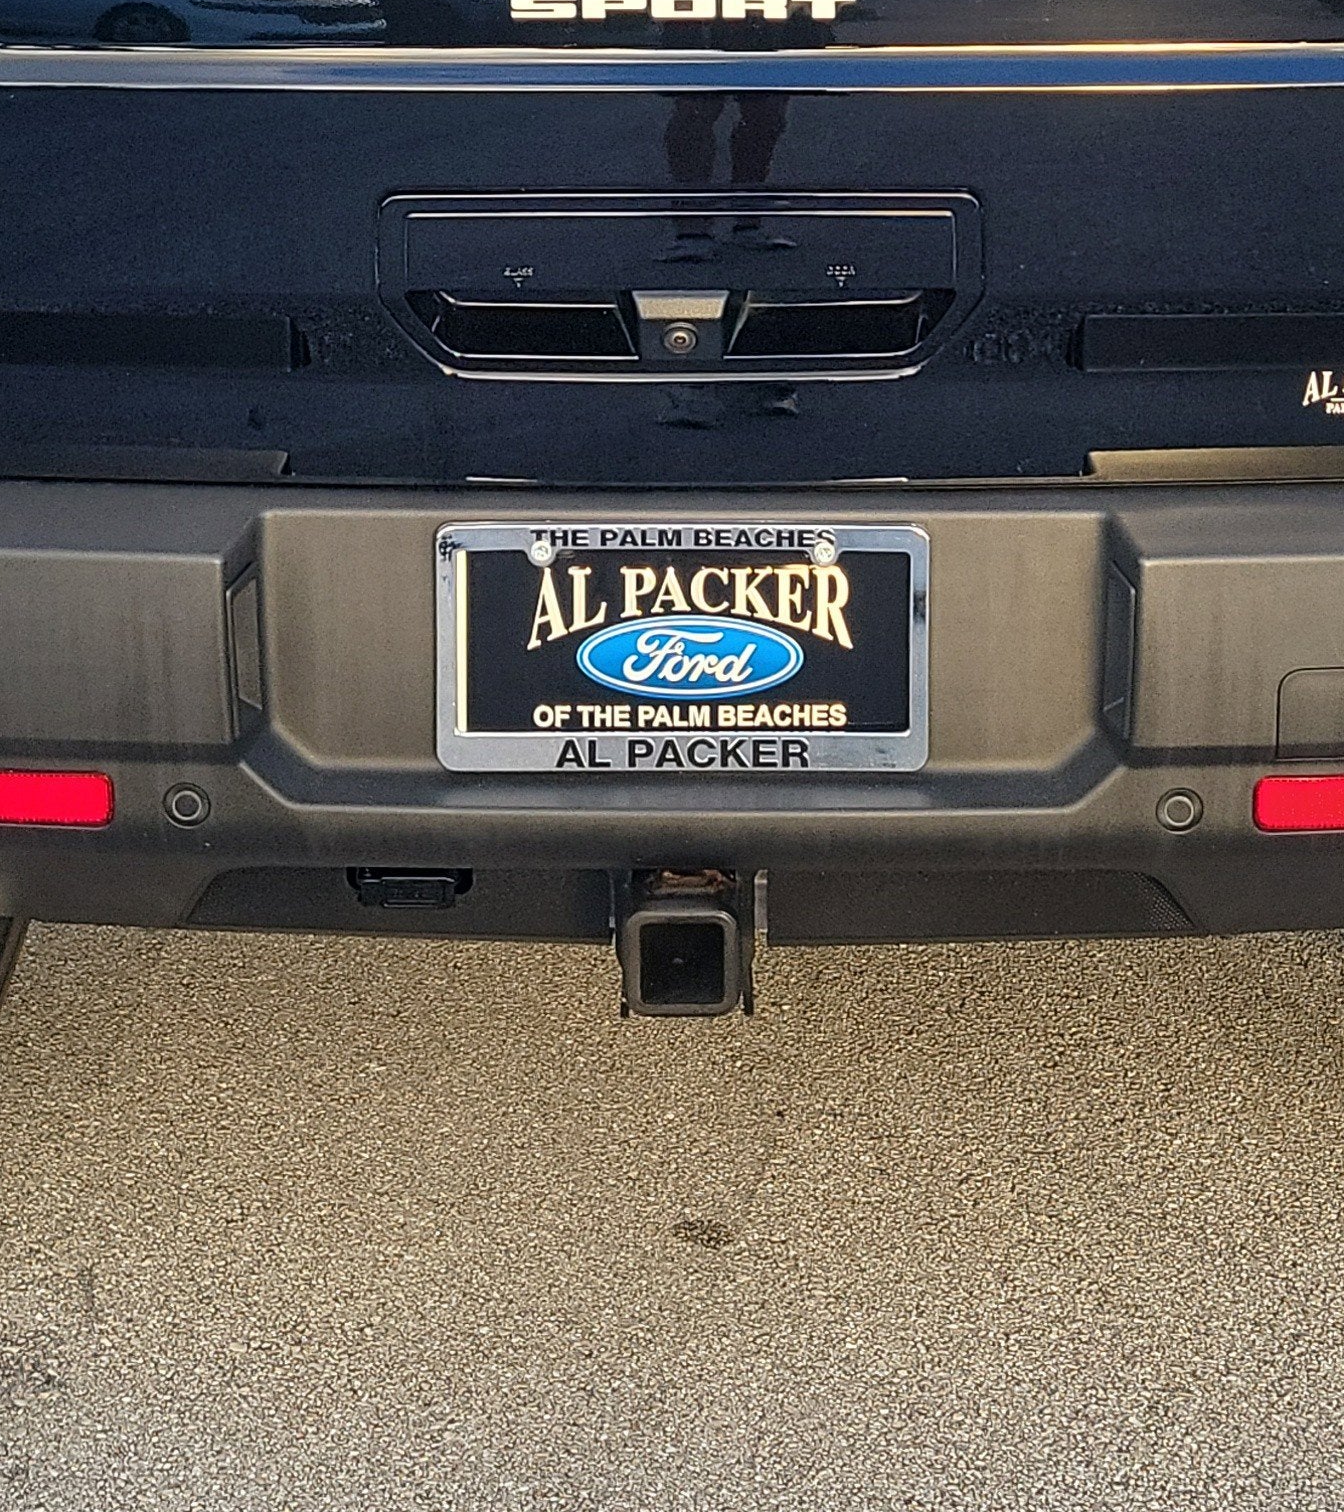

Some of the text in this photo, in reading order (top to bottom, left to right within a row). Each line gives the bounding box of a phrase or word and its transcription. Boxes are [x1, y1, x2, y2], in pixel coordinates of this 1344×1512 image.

[1302, 371, 1338, 407] AL
[530, 529, 836, 547] THE PALM BEACHES
[526, 564, 854, 650] AL PACKER
[623, 629, 758, 682] Ford
[533, 704, 847, 728] OF THE PALM BEACHES
[556, 739, 810, 769] AL PACKER
